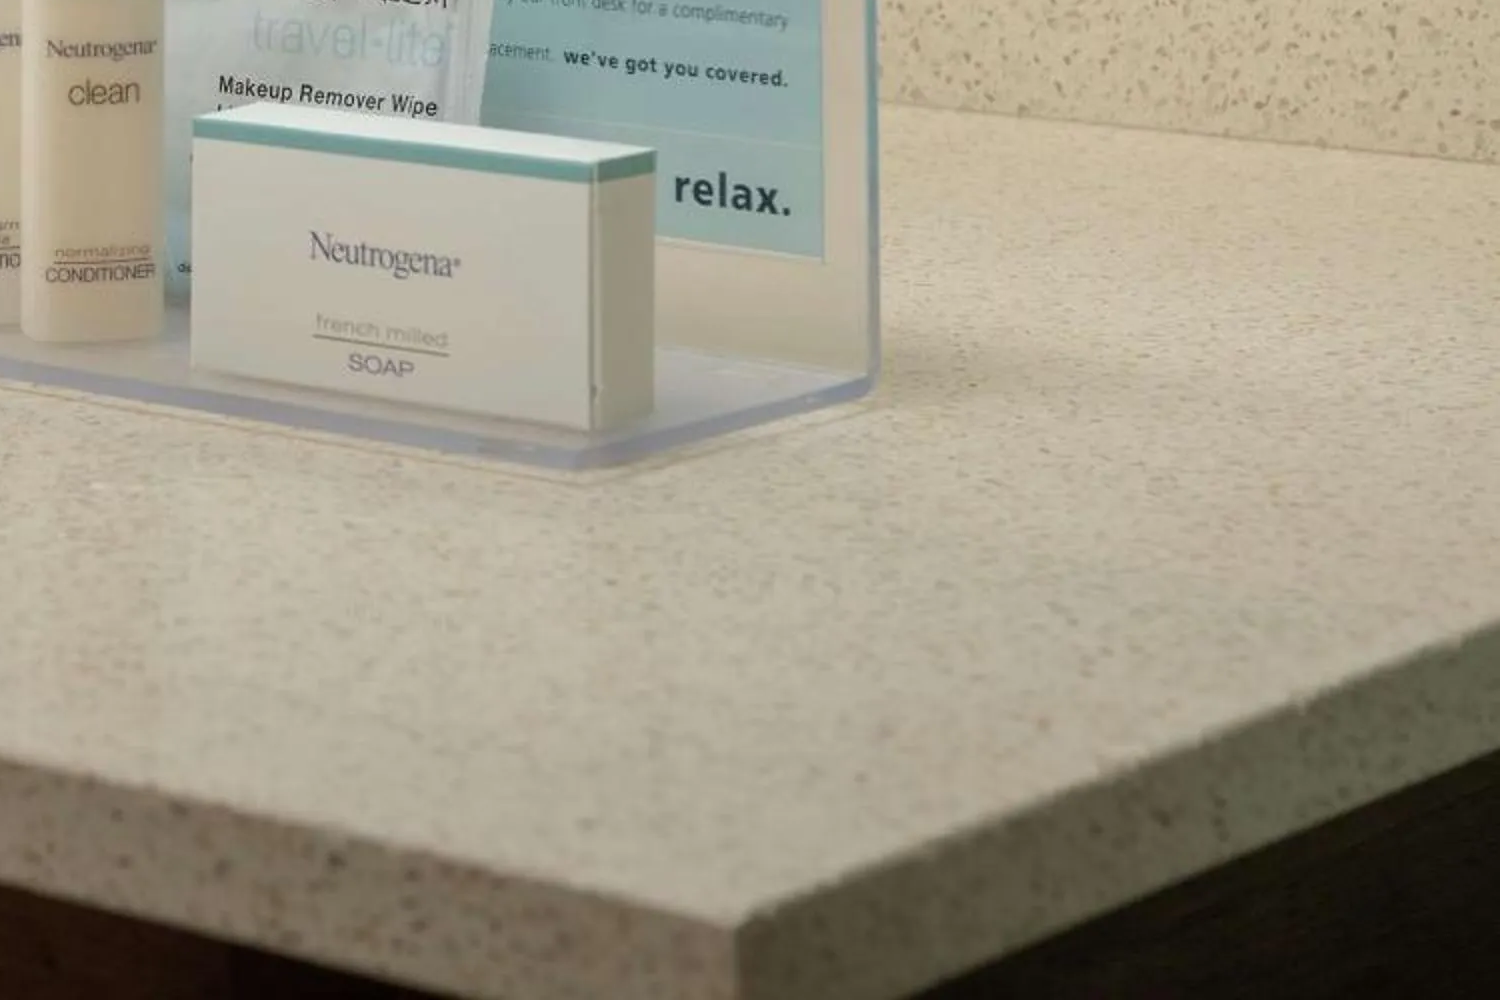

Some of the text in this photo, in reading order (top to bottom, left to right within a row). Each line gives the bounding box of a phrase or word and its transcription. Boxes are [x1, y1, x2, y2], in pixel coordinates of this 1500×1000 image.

[658, 3, 668, 17] a
[672, 3, 789, 33] complimentary
[563, 50, 619, 70] we've
[625, 57, 657, 76] got
[663, 61, 699, 80] you
[704, 66, 789, 88] covered.
[67, 78, 141, 107] clean
[219, 74, 438, 118] Makeup Remover Wipe
[674, 170, 792, 217] relax.
[45, 263, 156, 284] CONDITIONER
[316, 312, 449, 349] french milled
[347, 352, 415, 378] SOAP
